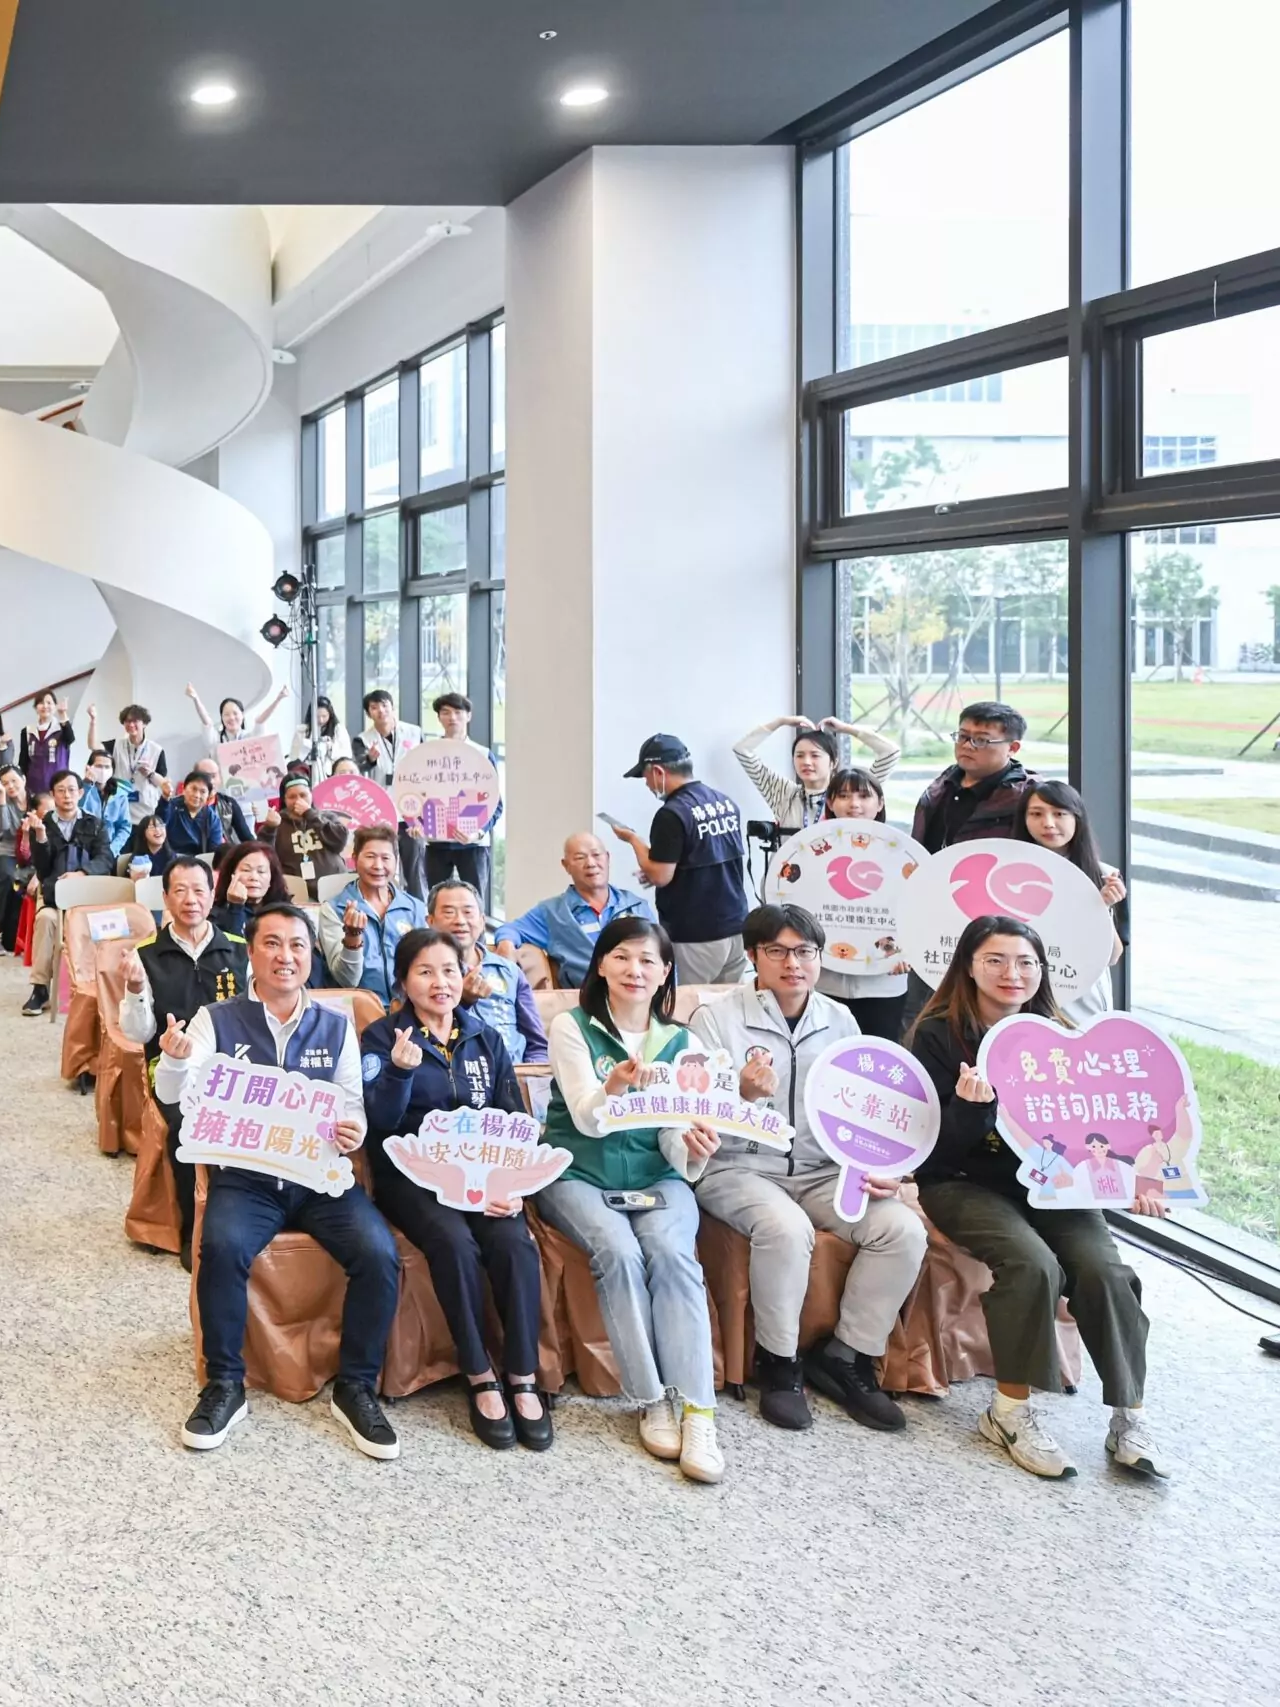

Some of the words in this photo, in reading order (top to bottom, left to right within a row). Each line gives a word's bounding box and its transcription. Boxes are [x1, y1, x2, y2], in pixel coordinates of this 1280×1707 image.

[697, 815, 739, 840] POLICE
[714, 1072, 733, 1092] 是
[1020, 1048, 1148, 1085] 免費心理
[203, 1064, 336, 1117] 打開心門
[1023, 1091, 1158, 1124] 諮詢服務
[424, 1112, 535, 1142] 心在楊梅
[608, 1094, 781, 1136] 心理健康推廣大使
[833, 1086, 912, 1133] 心靠站
[189, 1106, 322, 1162] 擁抱陽光
[428, 1141, 528, 1171] 安心相隨
